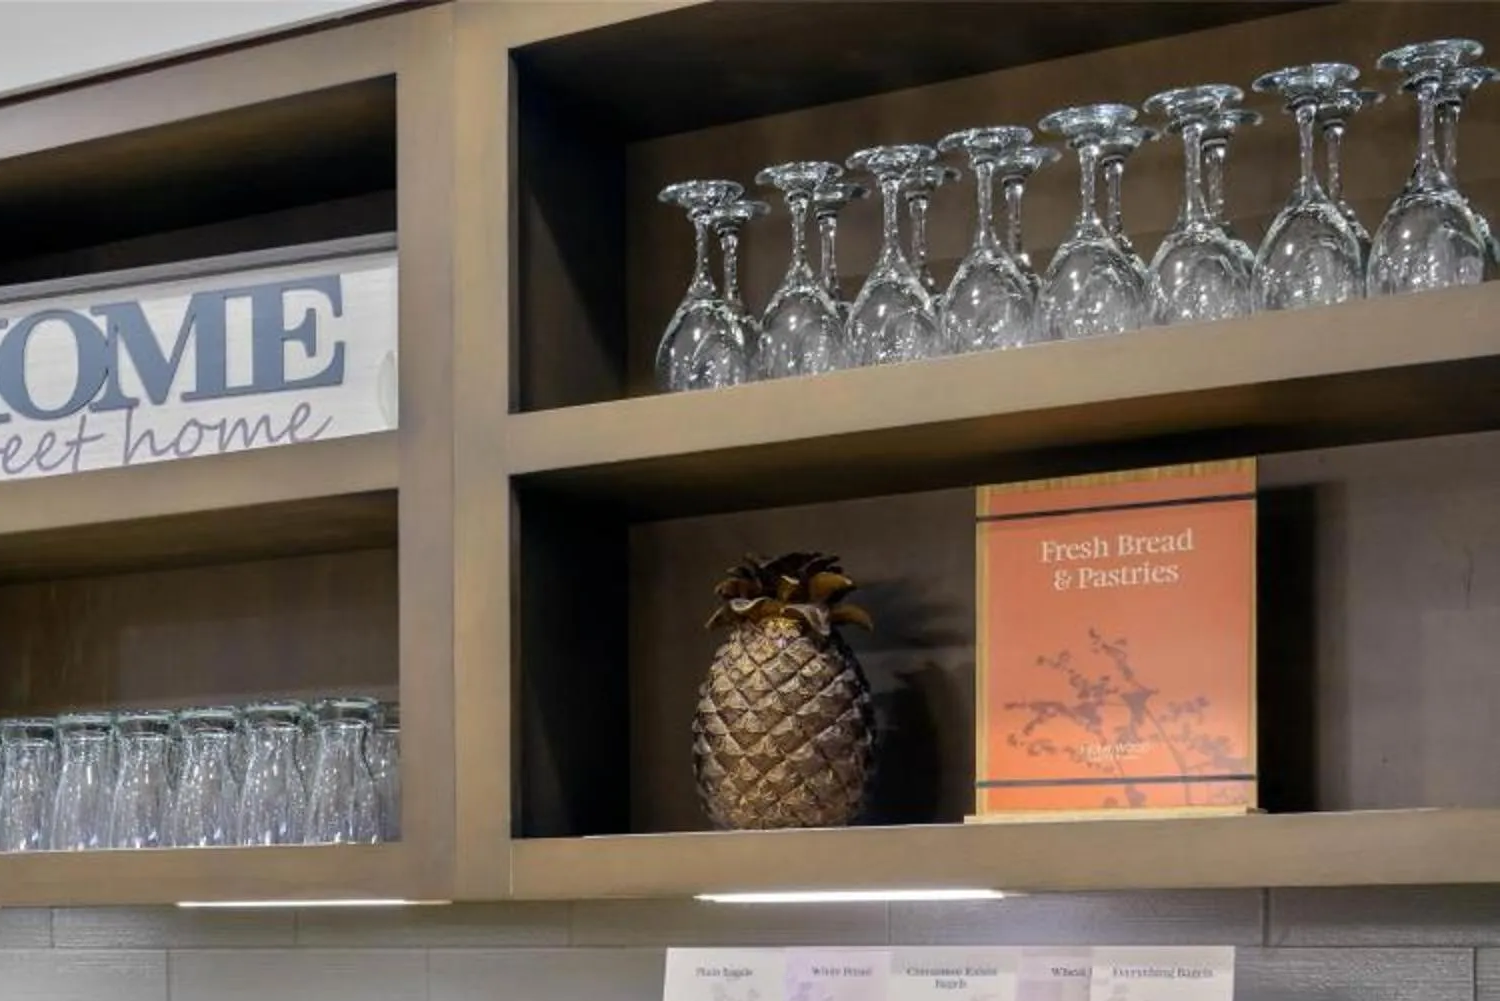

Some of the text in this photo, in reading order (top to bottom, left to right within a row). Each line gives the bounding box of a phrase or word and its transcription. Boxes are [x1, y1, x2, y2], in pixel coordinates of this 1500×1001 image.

[123, 401, 334, 462] home
[1040, 527, 1194, 563] Fresh Bread
[1053, 561, 1180, 591] & Pastries
